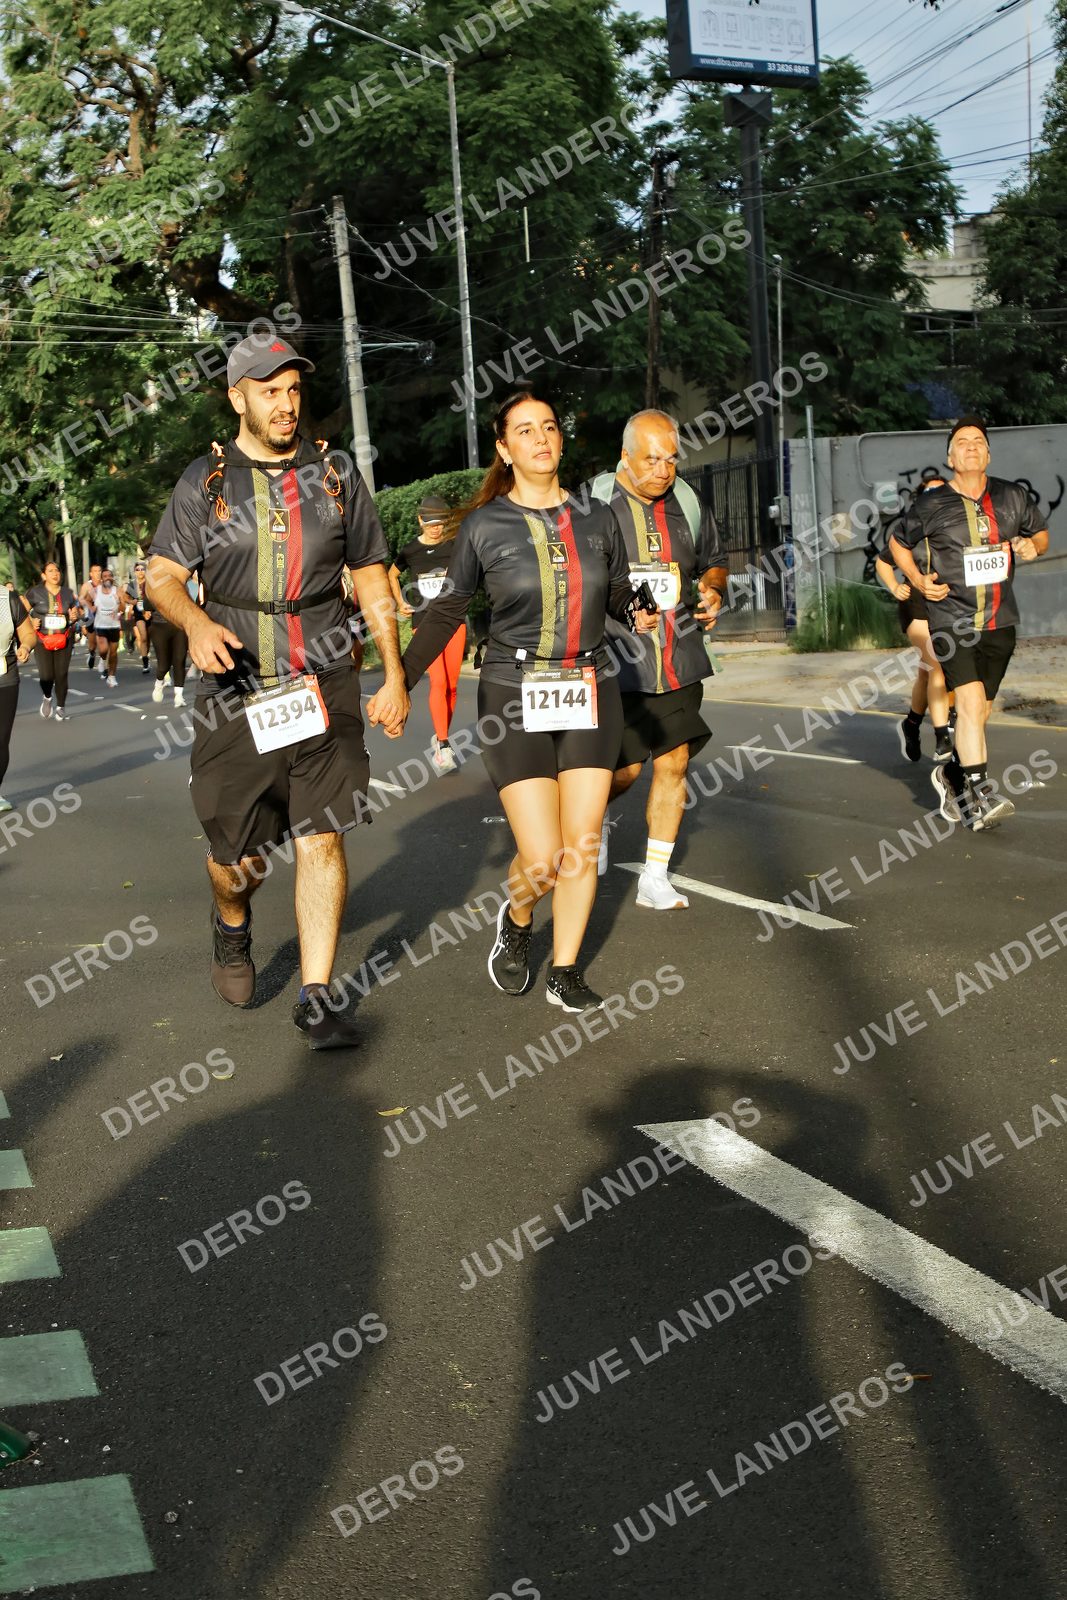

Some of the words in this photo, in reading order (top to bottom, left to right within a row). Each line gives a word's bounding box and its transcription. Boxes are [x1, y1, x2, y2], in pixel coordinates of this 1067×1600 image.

[967, 556, 1005, 572] 10683
[527, 688, 587, 710] 12144
[252, 695, 317, 731] 12394
